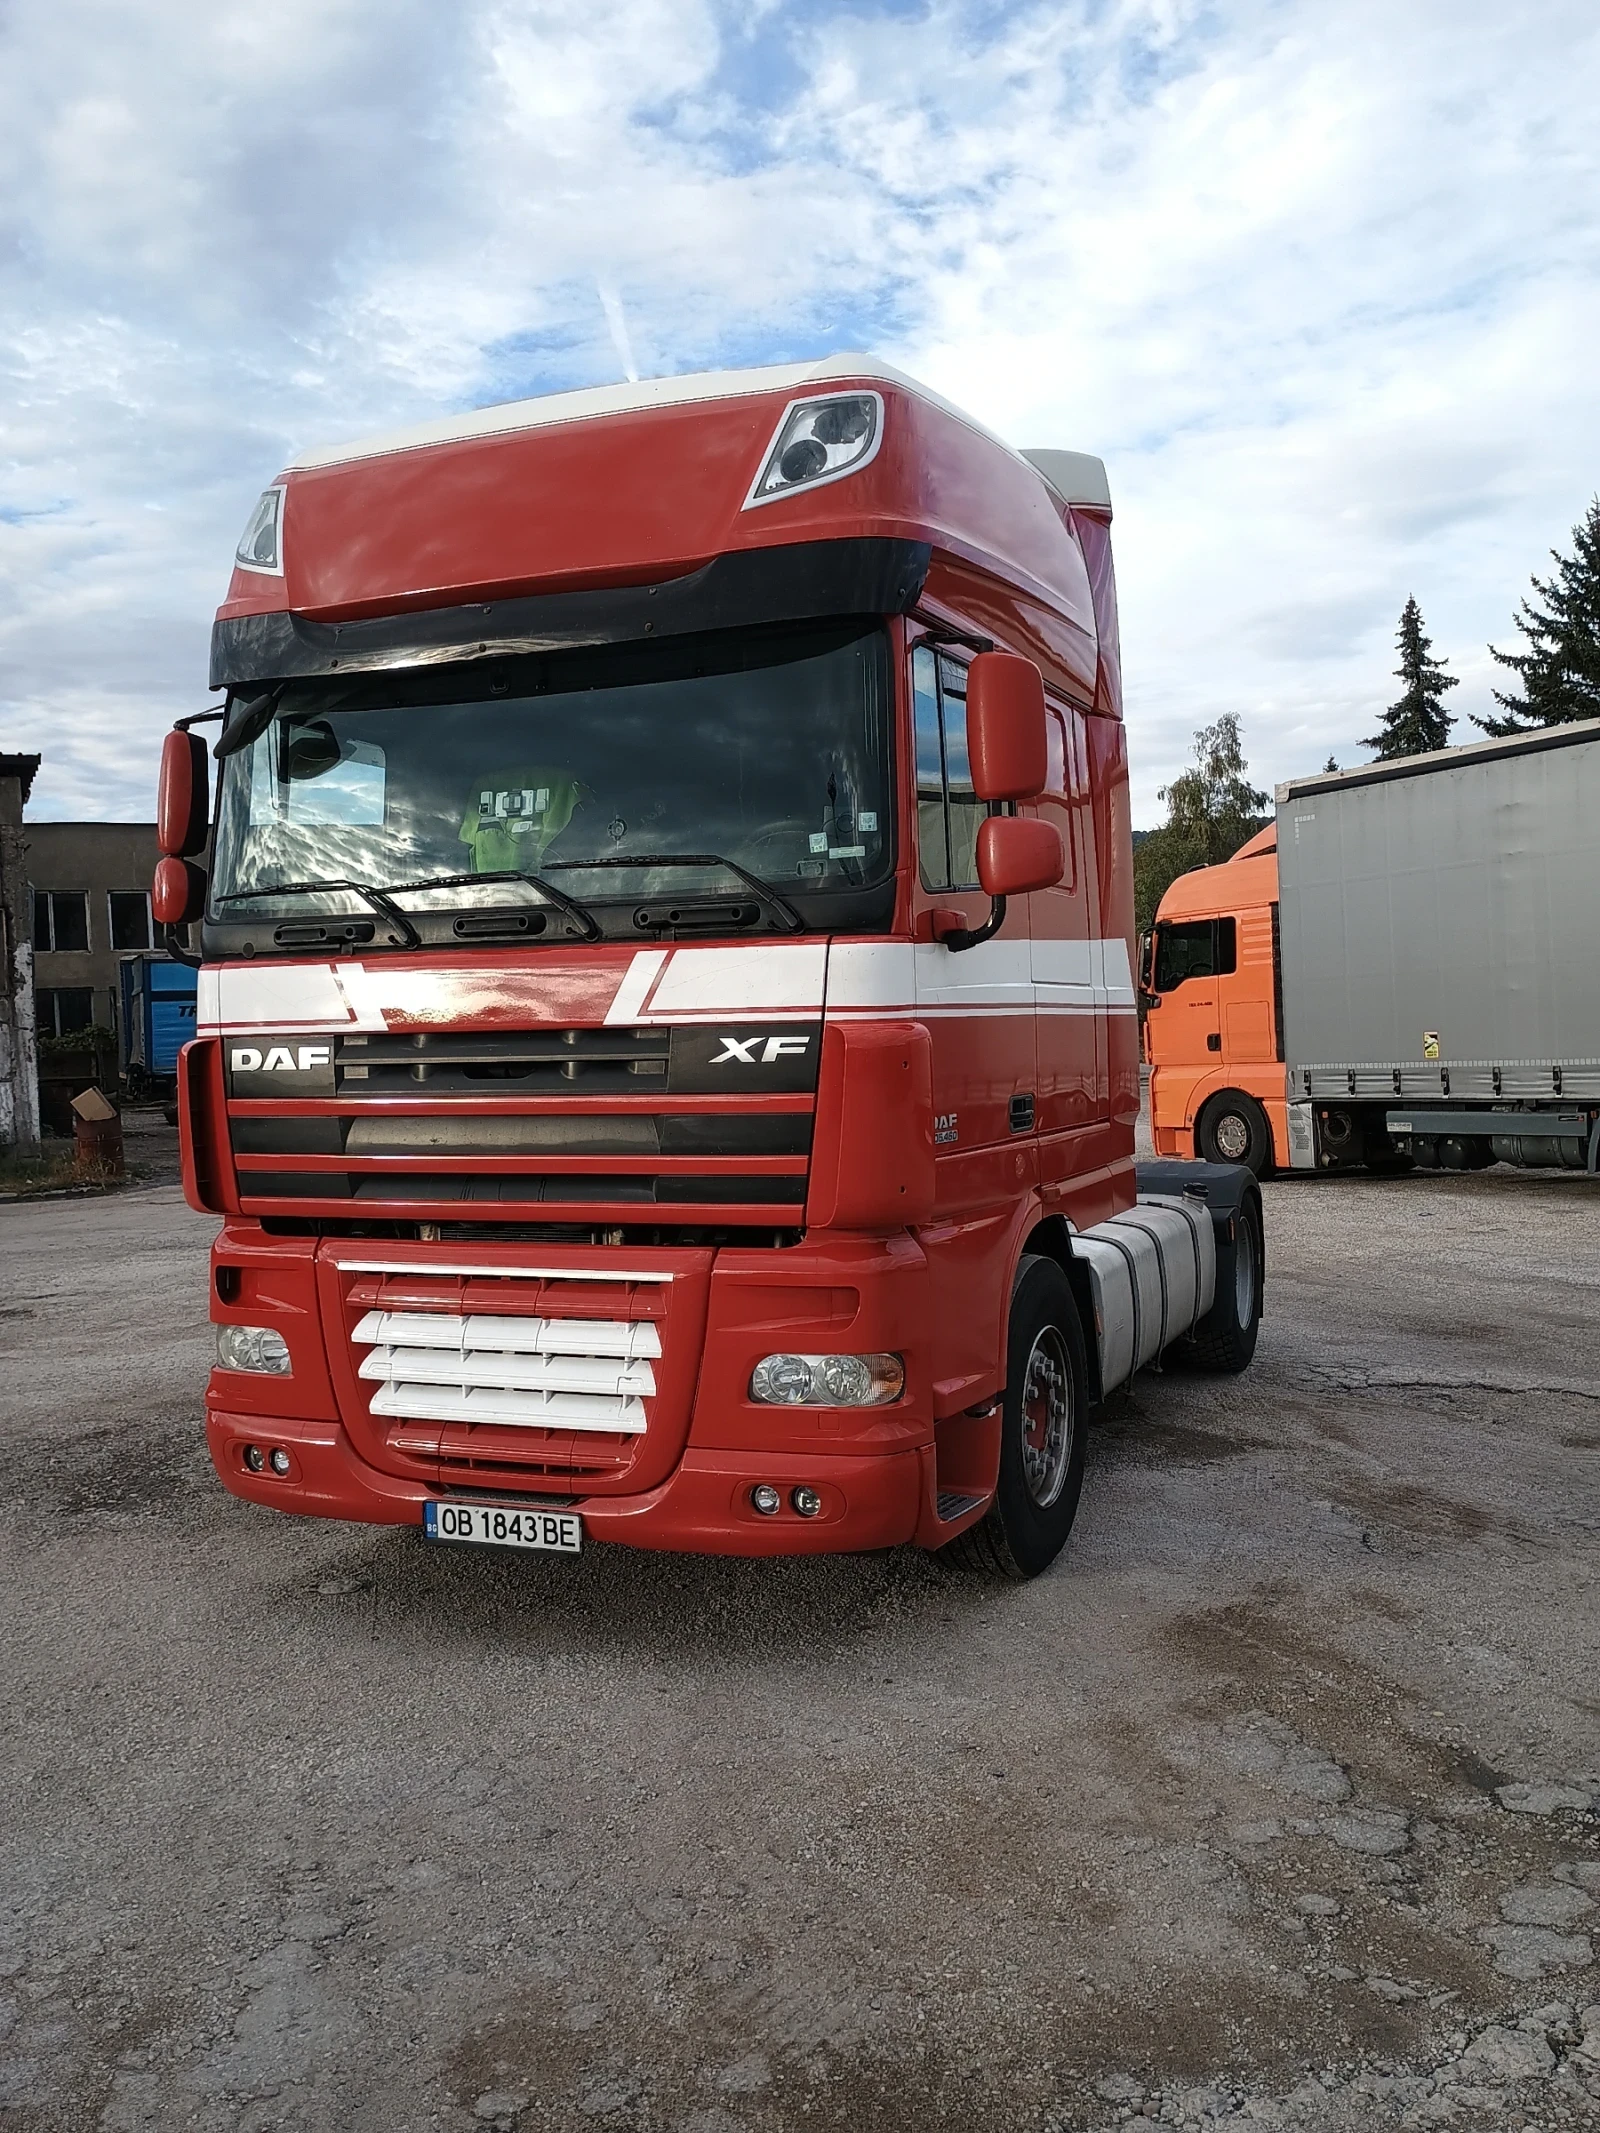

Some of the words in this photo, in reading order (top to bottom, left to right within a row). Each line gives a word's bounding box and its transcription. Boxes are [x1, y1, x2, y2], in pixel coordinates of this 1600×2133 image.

[231, 1046, 330, 1072] DAF
[708, 1036, 810, 1063] XF
[427, 1523, 438, 1533] BG
[441, 1508, 473, 1537] OB
[481, 1511, 538, 1543] 1843
[543, 1517, 576, 1547] BE
